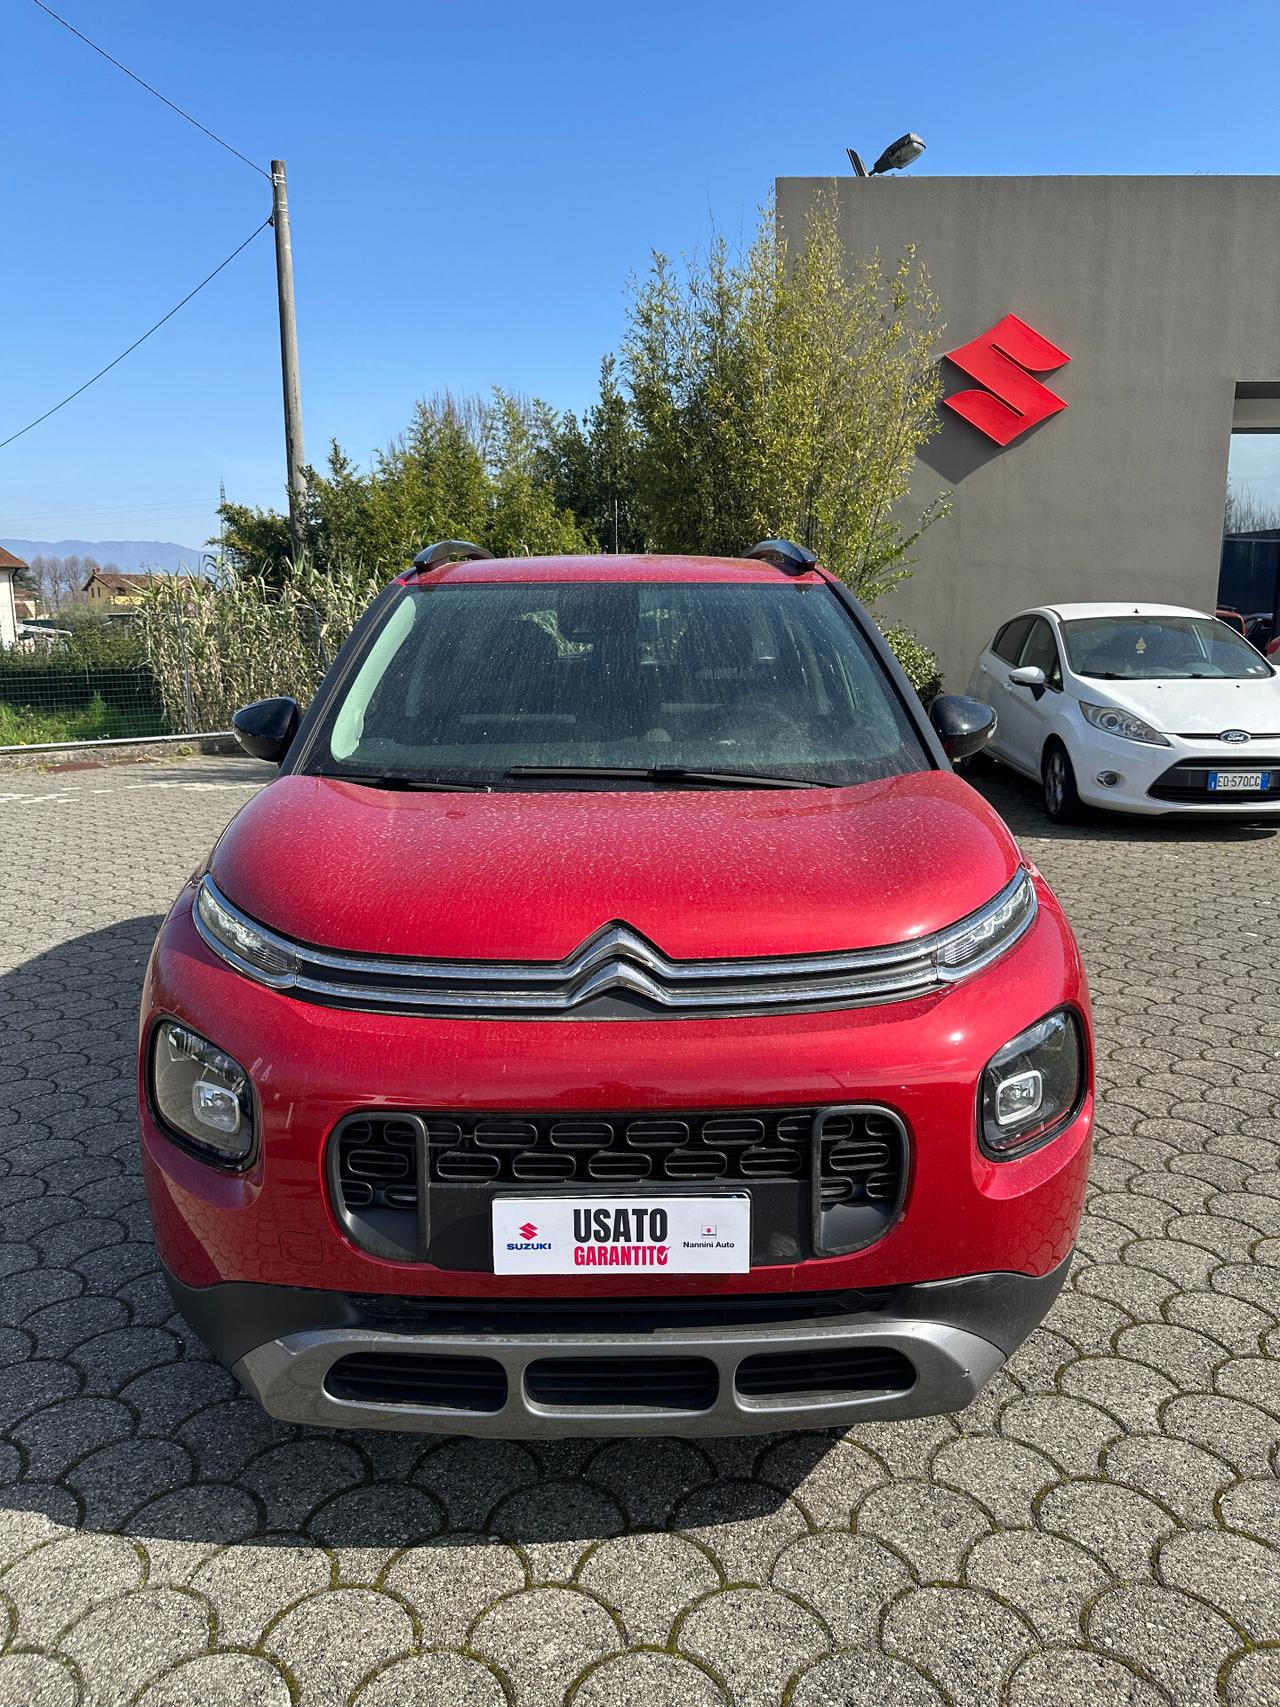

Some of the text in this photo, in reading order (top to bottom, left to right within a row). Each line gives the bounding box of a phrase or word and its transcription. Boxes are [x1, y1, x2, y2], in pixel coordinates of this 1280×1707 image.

[573, 1208, 668, 1243] USATO
[506, 1243, 552, 1251] SUZUKI
[683, 1241, 735, 1249] Nannini Auto
[574, 1245, 671, 1266] GARANTITO
